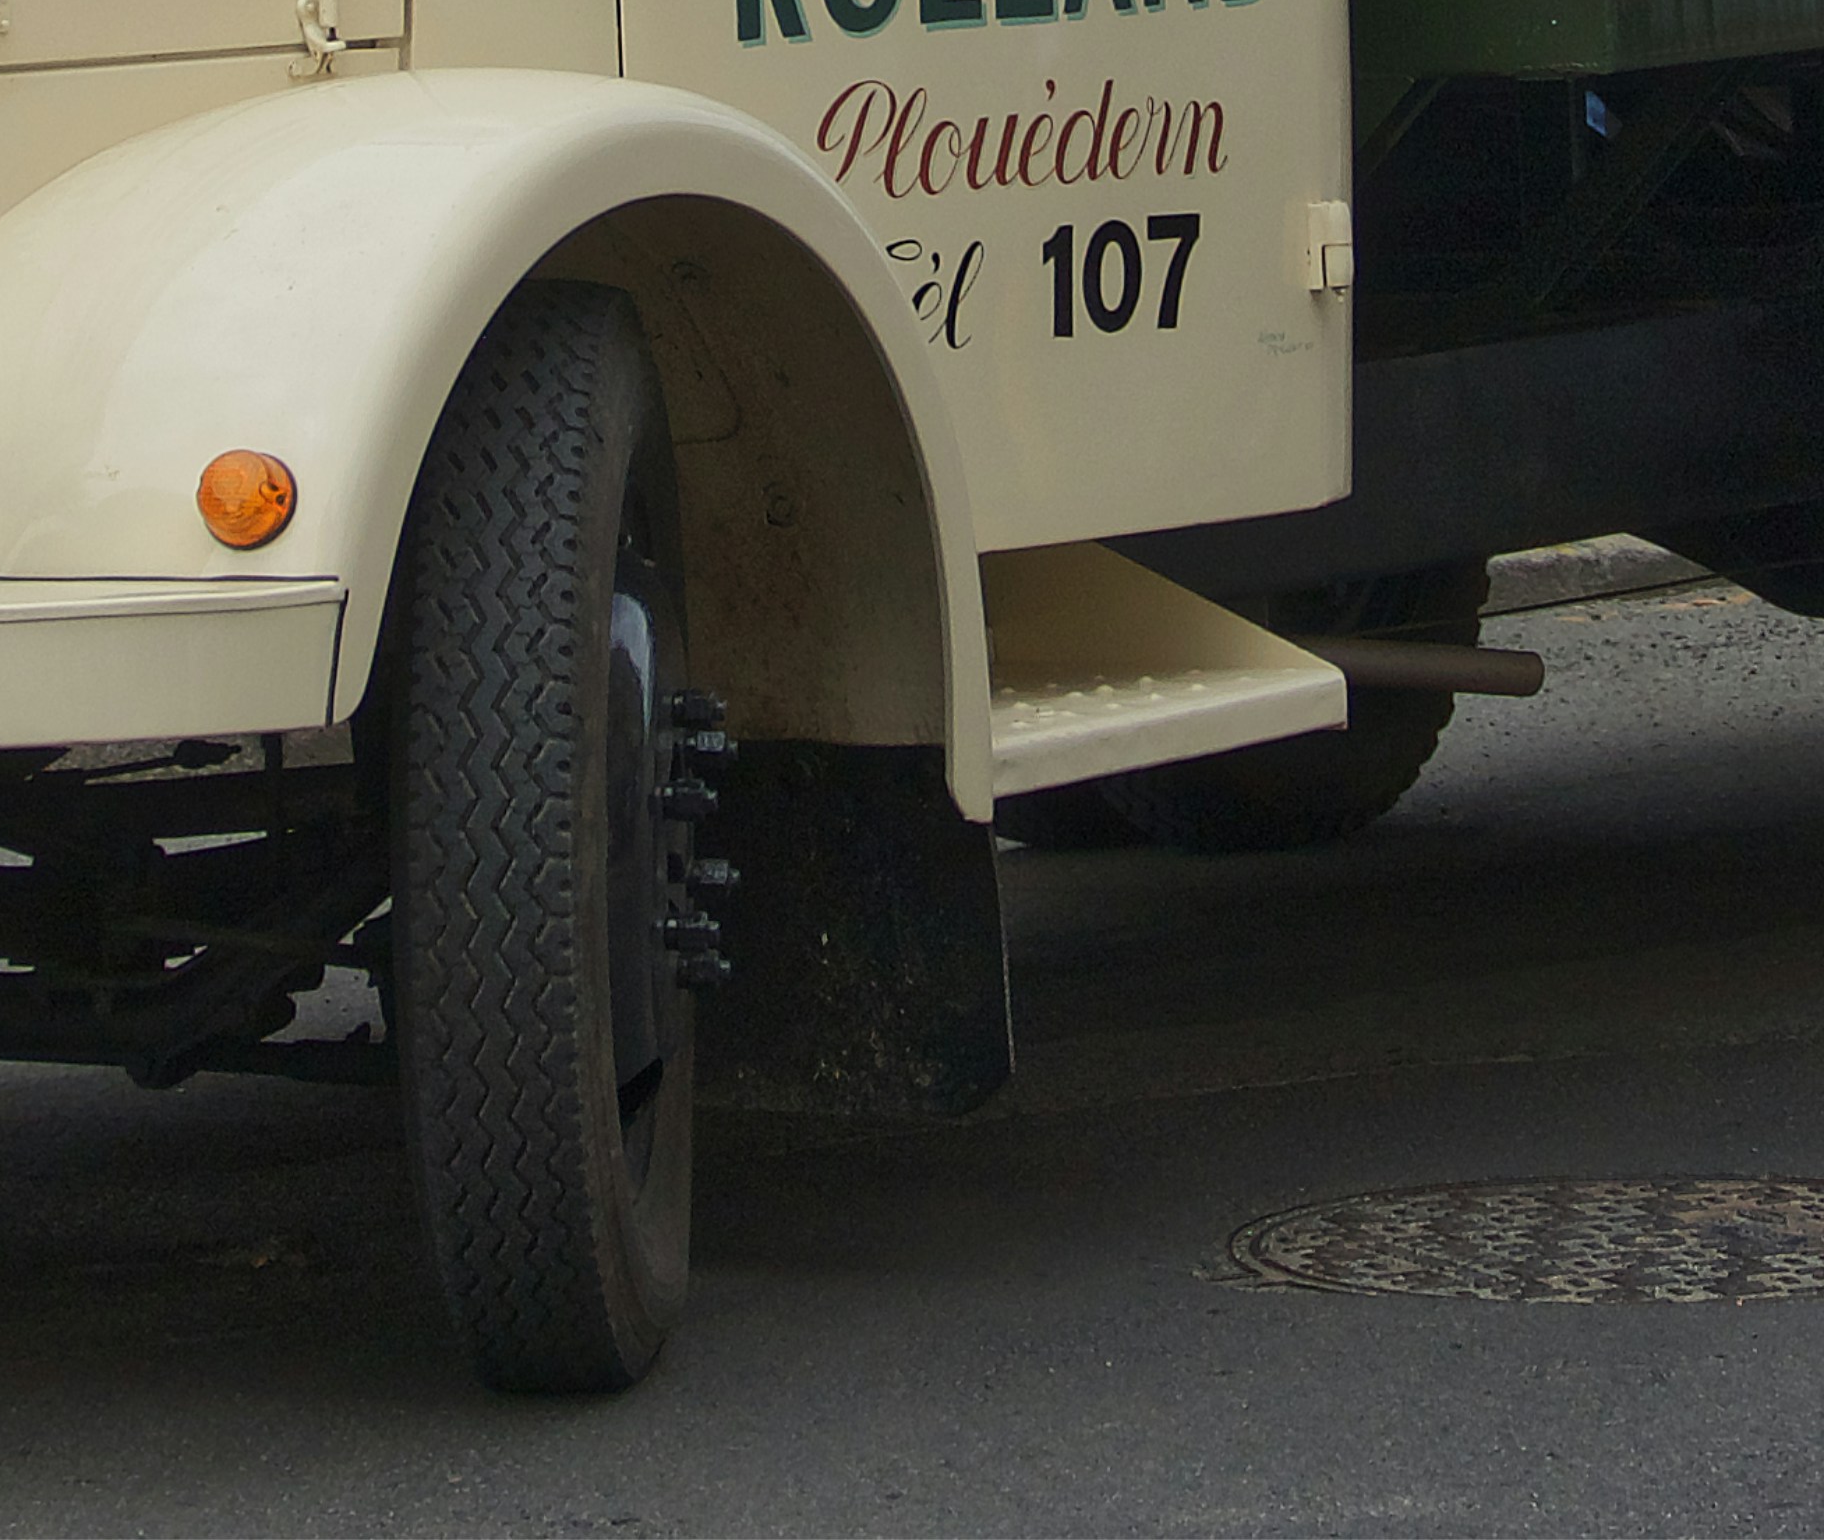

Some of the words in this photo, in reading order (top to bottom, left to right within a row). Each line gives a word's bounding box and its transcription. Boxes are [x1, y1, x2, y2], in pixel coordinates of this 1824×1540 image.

[816, 77, 1229, 200] Plouédern
[885, 238, 984, 350] él
[1042, 213, 1200, 339] 107
